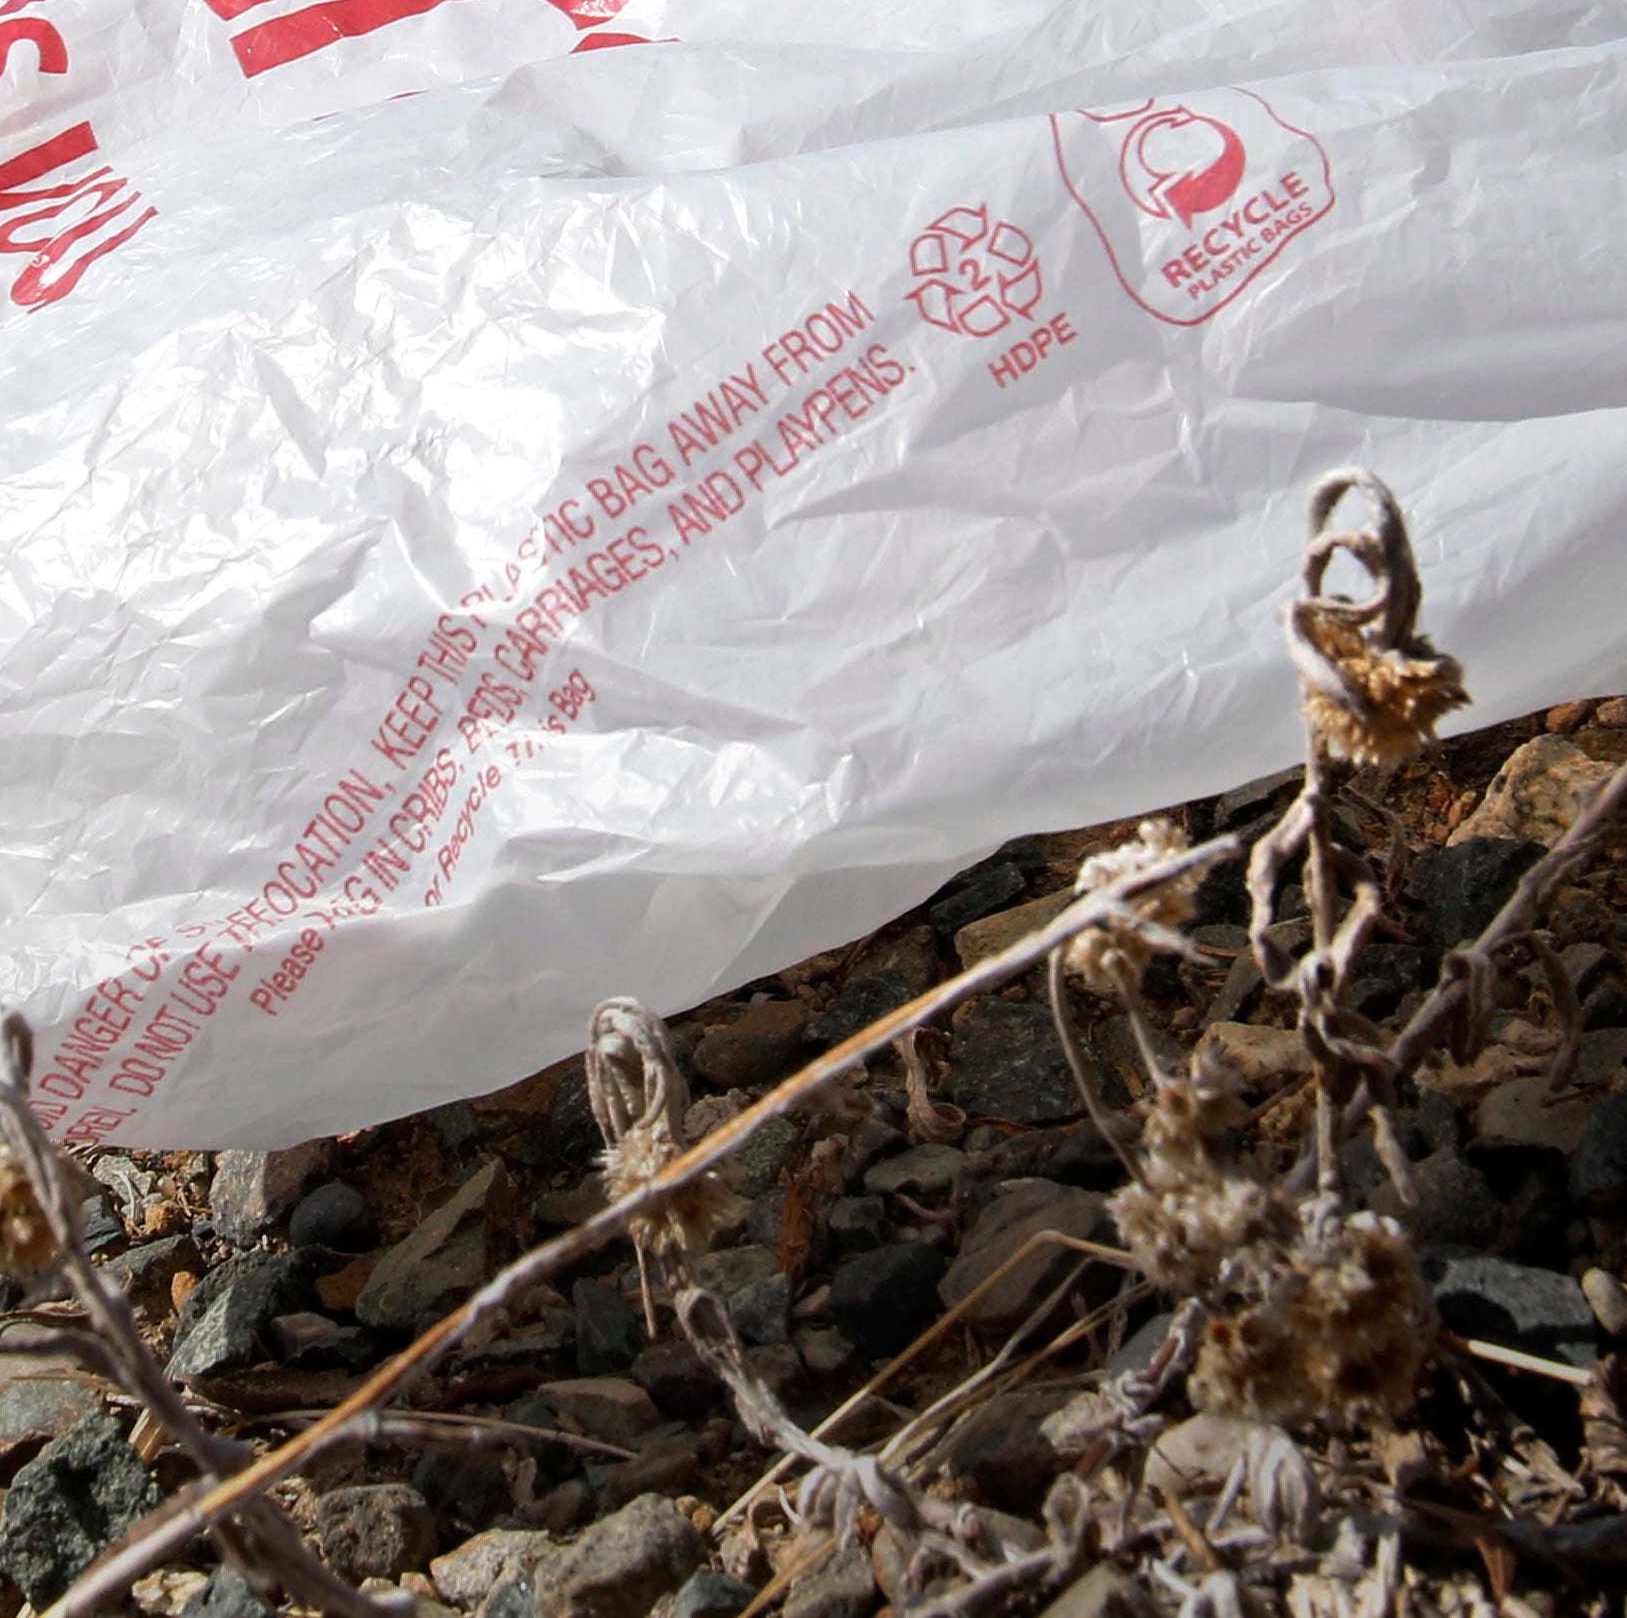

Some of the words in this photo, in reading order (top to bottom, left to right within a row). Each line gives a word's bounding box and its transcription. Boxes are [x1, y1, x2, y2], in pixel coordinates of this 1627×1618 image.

[958, 258, 992, 291] 2
[1160, 171, 1310, 289] RECYCLE
[1186, 238, 1261, 300] PLASTIC
[1259, 201, 1315, 248] BAGS
[986, 312, 1079, 389] HDPE
[734, 342, 917, 493] PLAYPENS.
[666, 469, 746, 547] AND
[493, 525, 680, 685] CARRIAGES,
[39, 977, 144, 1100] DANGER
[371, 674, 445, 771] KEEP
[418, 613, 478, 686] THIS
[585, 444, 676, 519] BAG
[667, 362, 769, 467] AWAY
[762, 289, 876, 388] FROM
[388, 747, 466, 854] CRIBS,
[437, 765, 503, 882] Recycle
[548, 667, 598, 722] Bag
[362, 838, 411, 893] IN
[170, 940, 241, 1017] USE
[247, 927, 325, 1017] Please
[134, 1002, 201, 1062] NOT
[109, 1056, 167, 1099] DO
